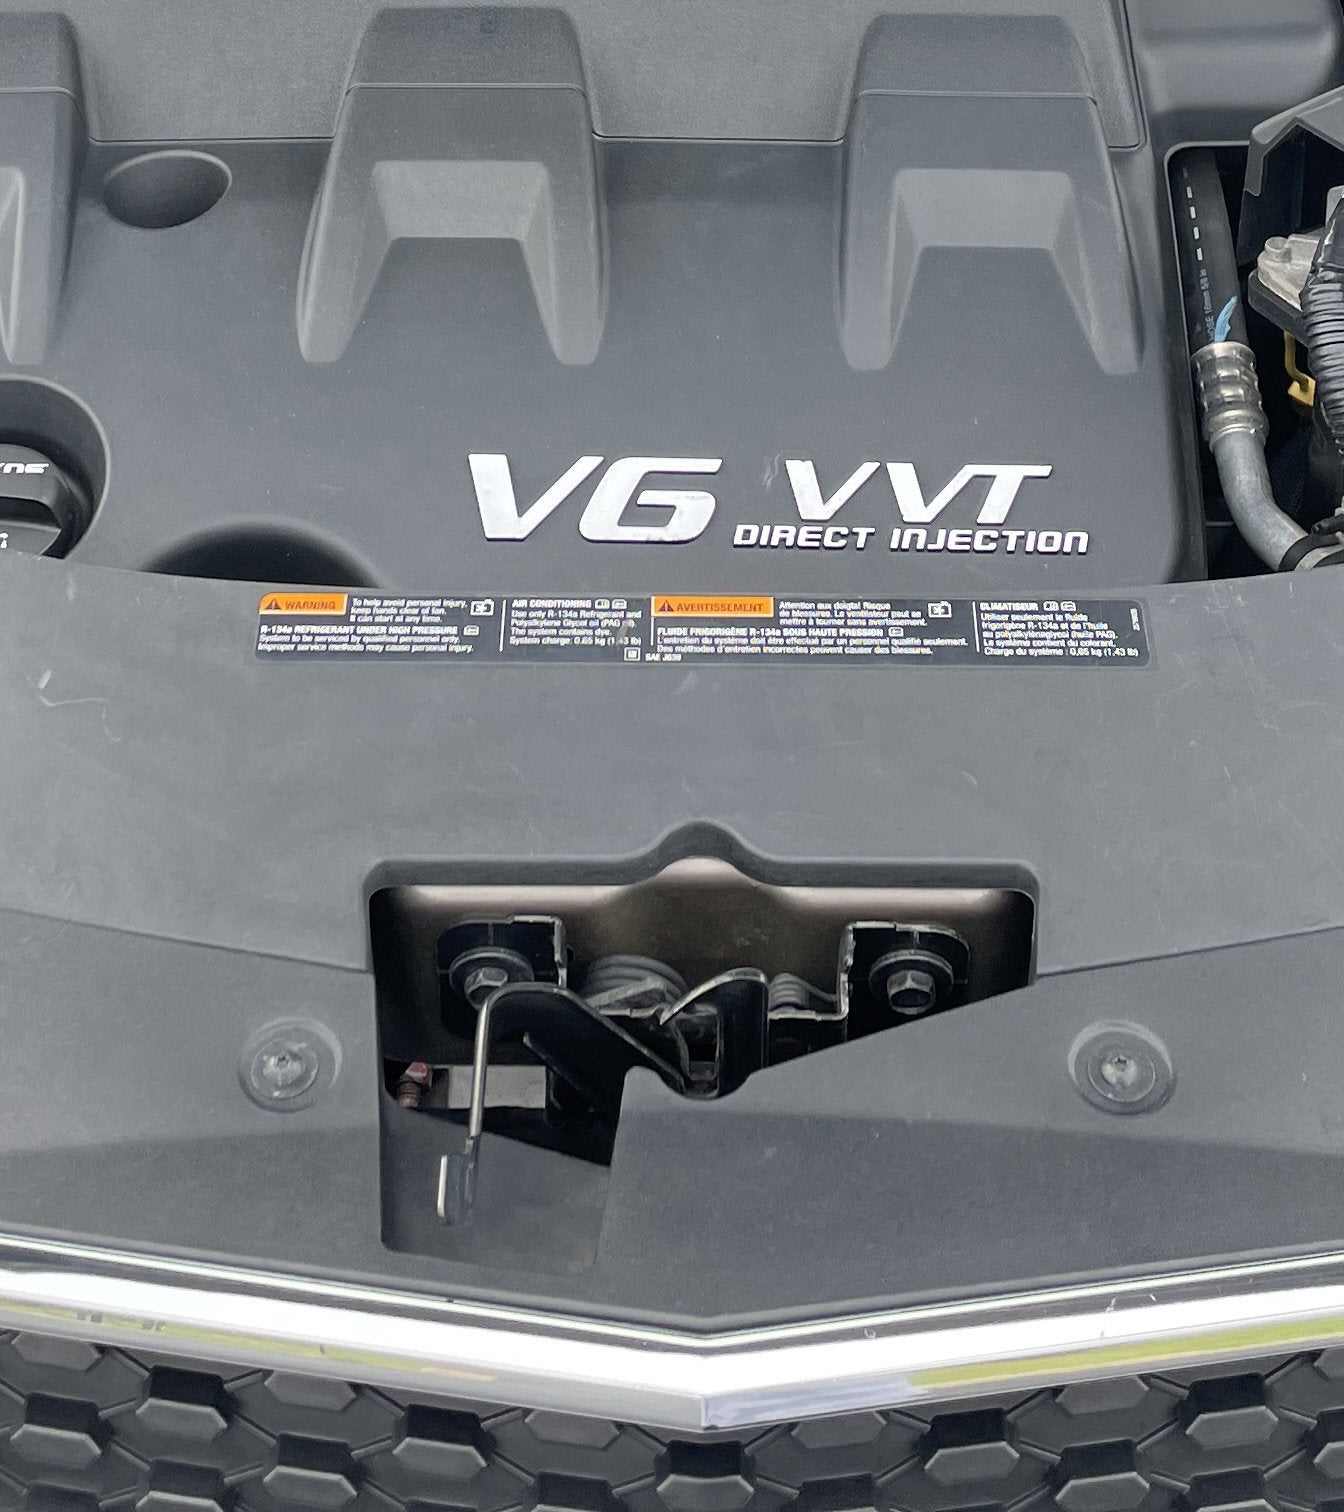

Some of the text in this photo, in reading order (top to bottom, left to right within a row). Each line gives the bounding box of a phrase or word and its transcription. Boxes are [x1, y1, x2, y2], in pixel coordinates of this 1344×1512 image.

[467, 453, 1053, 543] V6 VVT
[734, 525, 1090, 554] DIRECT INJECTION
[286, 601, 335, 610] WARNING
[363, 599, 381, 607] help
[406, 599, 441, 608] personal
[513, 600, 591, 608] AIR CONDITIONING
[677, 603, 763, 611] AVERTISSEMENT
[980, 603, 1038, 611] CLIMATISEUR
[512, 610, 527, 618] Use
[529, 611, 545, 619] only
[294, 626, 354, 634] REFRIGERANT
[357, 626, 386, 634] UNDER
[389, 626, 410, 634] HIGH
[412, 626, 457, 634] PRESSURE
[658, 628, 687, 636] FLUIDE
[783, 628, 806, 636] SOUS
[809, 628, 837, 636] HAUTE
[840, 628, 883, 636] PRESSION
[510, 637, 539, 645] System
[822, 638, 834, 646] par
[850, 638, 889, 646] personnel
[412, 645, 447, 653] personal
[985, 648, 1013, 656] Charge
[1091, 649, 1102, 657] kg
